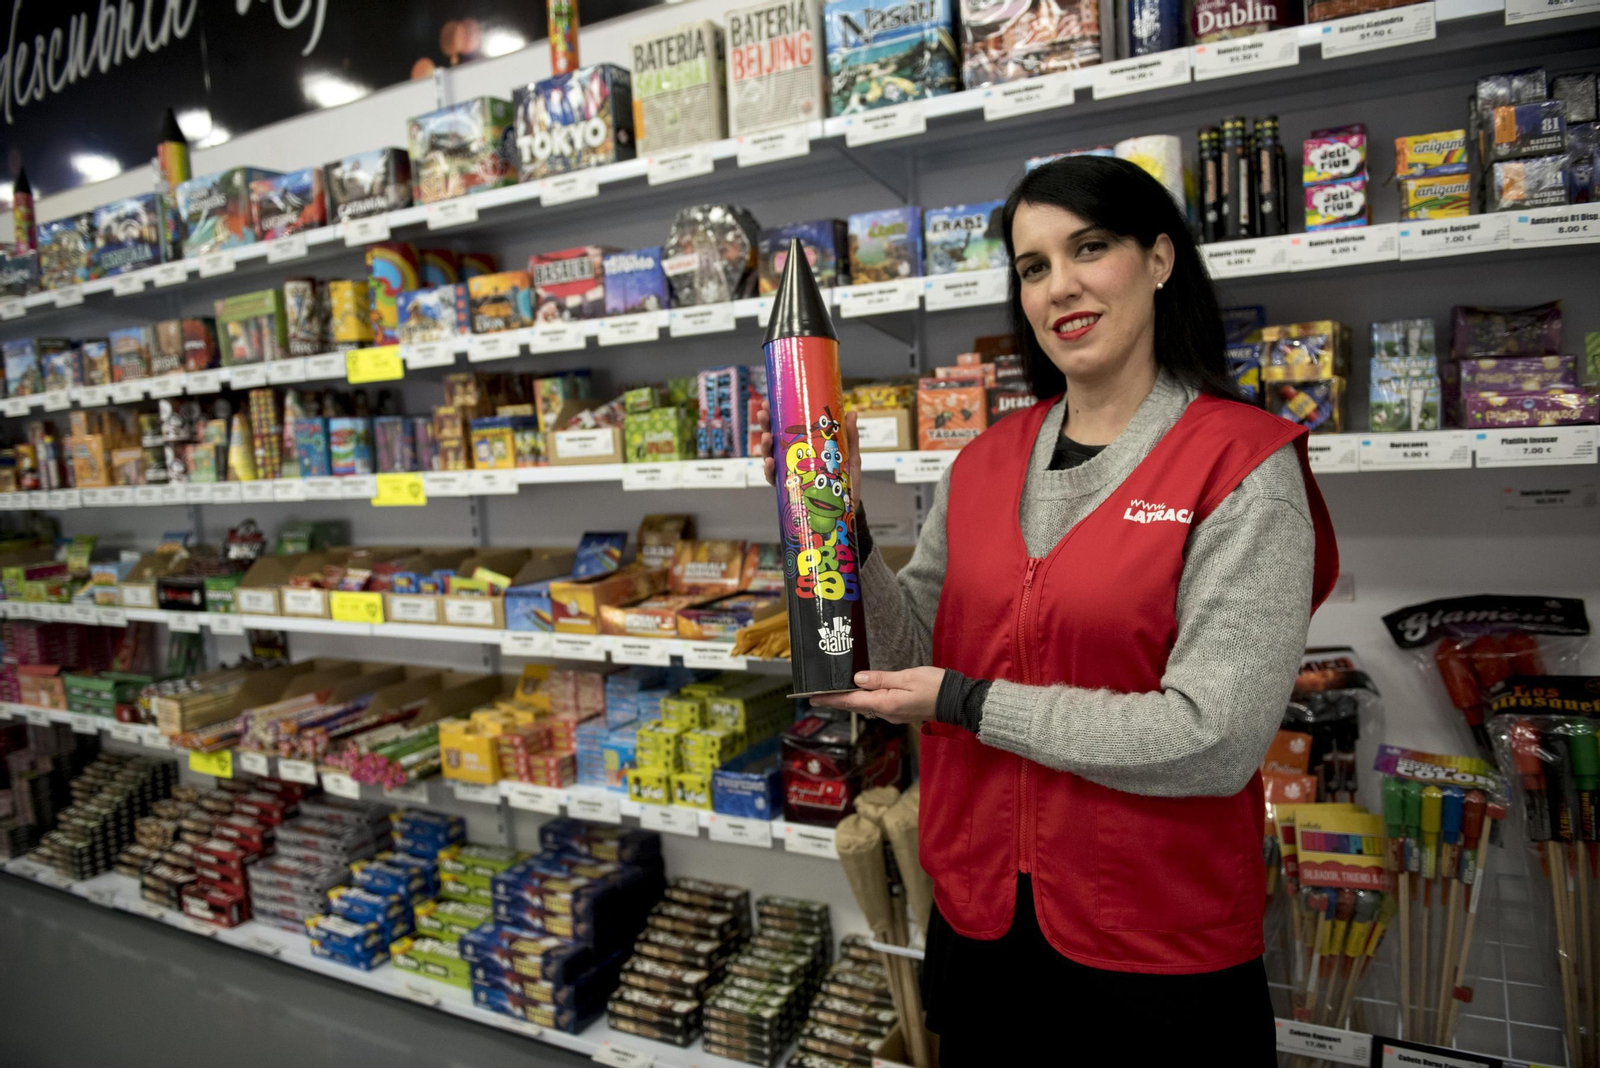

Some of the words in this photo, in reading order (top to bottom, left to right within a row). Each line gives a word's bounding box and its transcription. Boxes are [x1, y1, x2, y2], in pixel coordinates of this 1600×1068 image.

[731, 2, 811, 48] BATERIA
[1197, 0, 1278, 35] Dublin
[634, 28, 707, 74] BATERIA
[732, 32, 812, 81] BEIJING
[1541, 117, 1560, 132] 81
[516, 117, 608, 163] TOKYO
[1413, 138, 1466, 156] anigami
[1416, 182, 1470, 200] anigami
[931, 214, 985, 234] KRABI
[1512, 685, 1560, 699] Los
